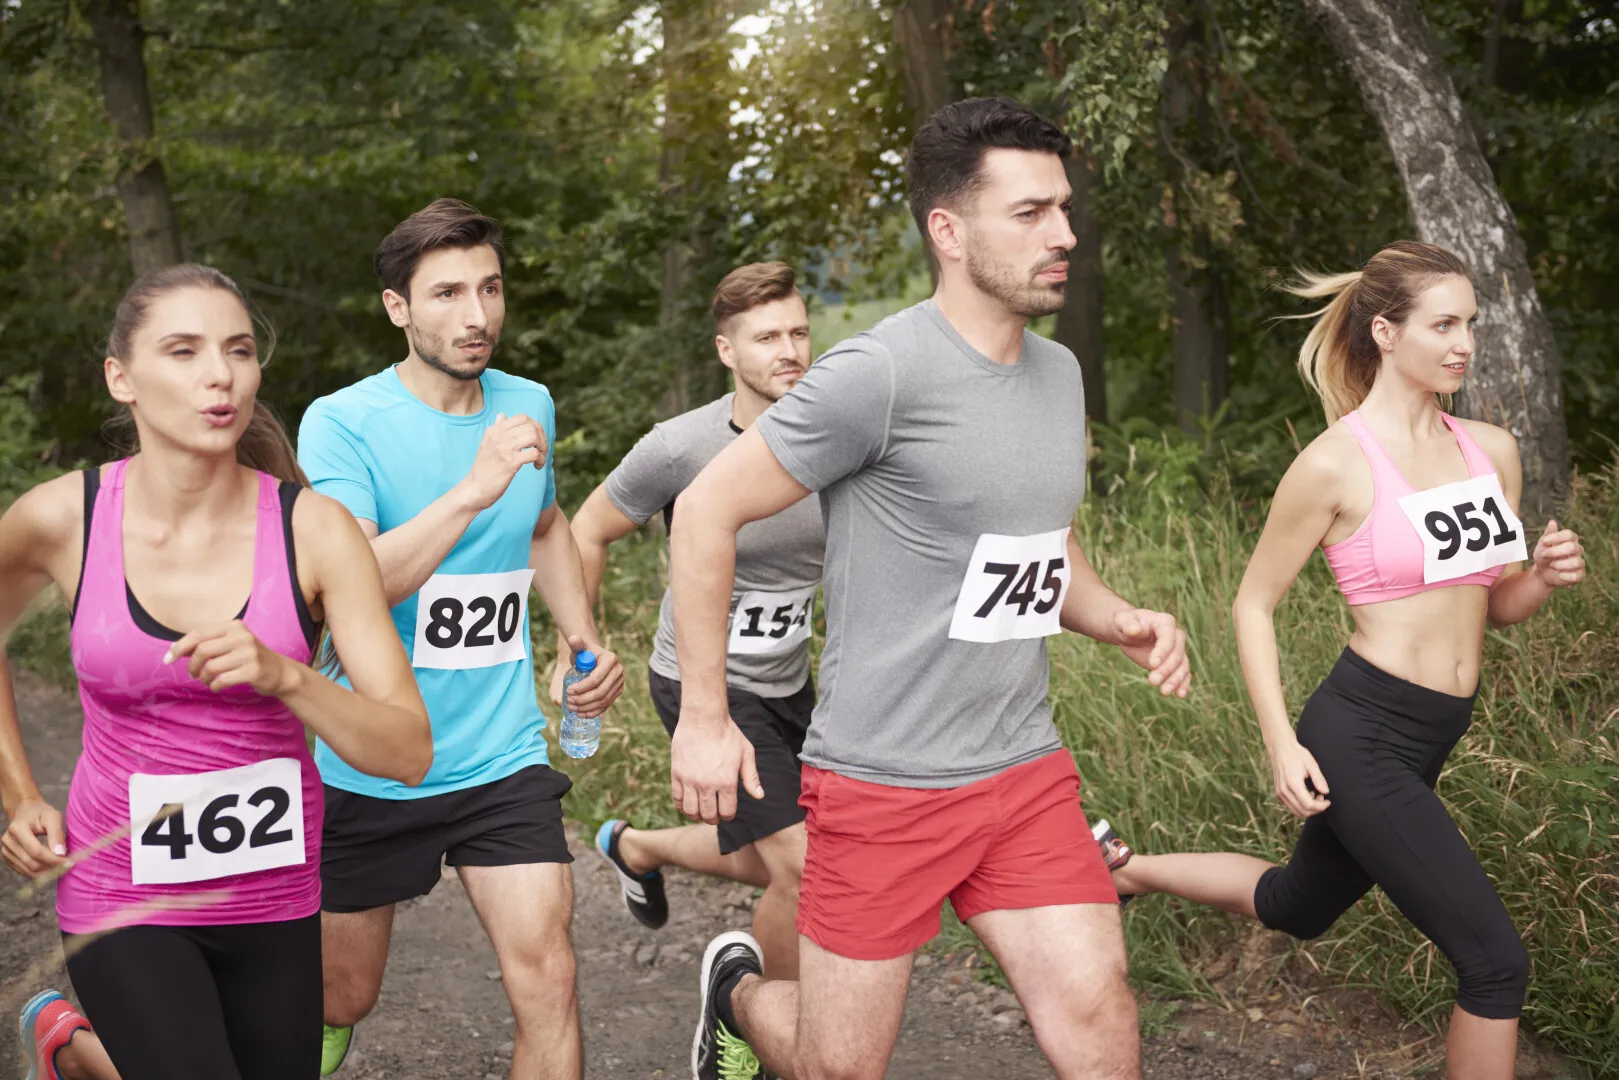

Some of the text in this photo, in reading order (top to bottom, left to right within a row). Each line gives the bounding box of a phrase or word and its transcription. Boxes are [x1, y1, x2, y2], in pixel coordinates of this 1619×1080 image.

[1424, 496, 1516, 560] 951
[973, 558, 1064, 617] 745
[425, 592, 520, 649] 820
[140, 786, 293, 859] 462
